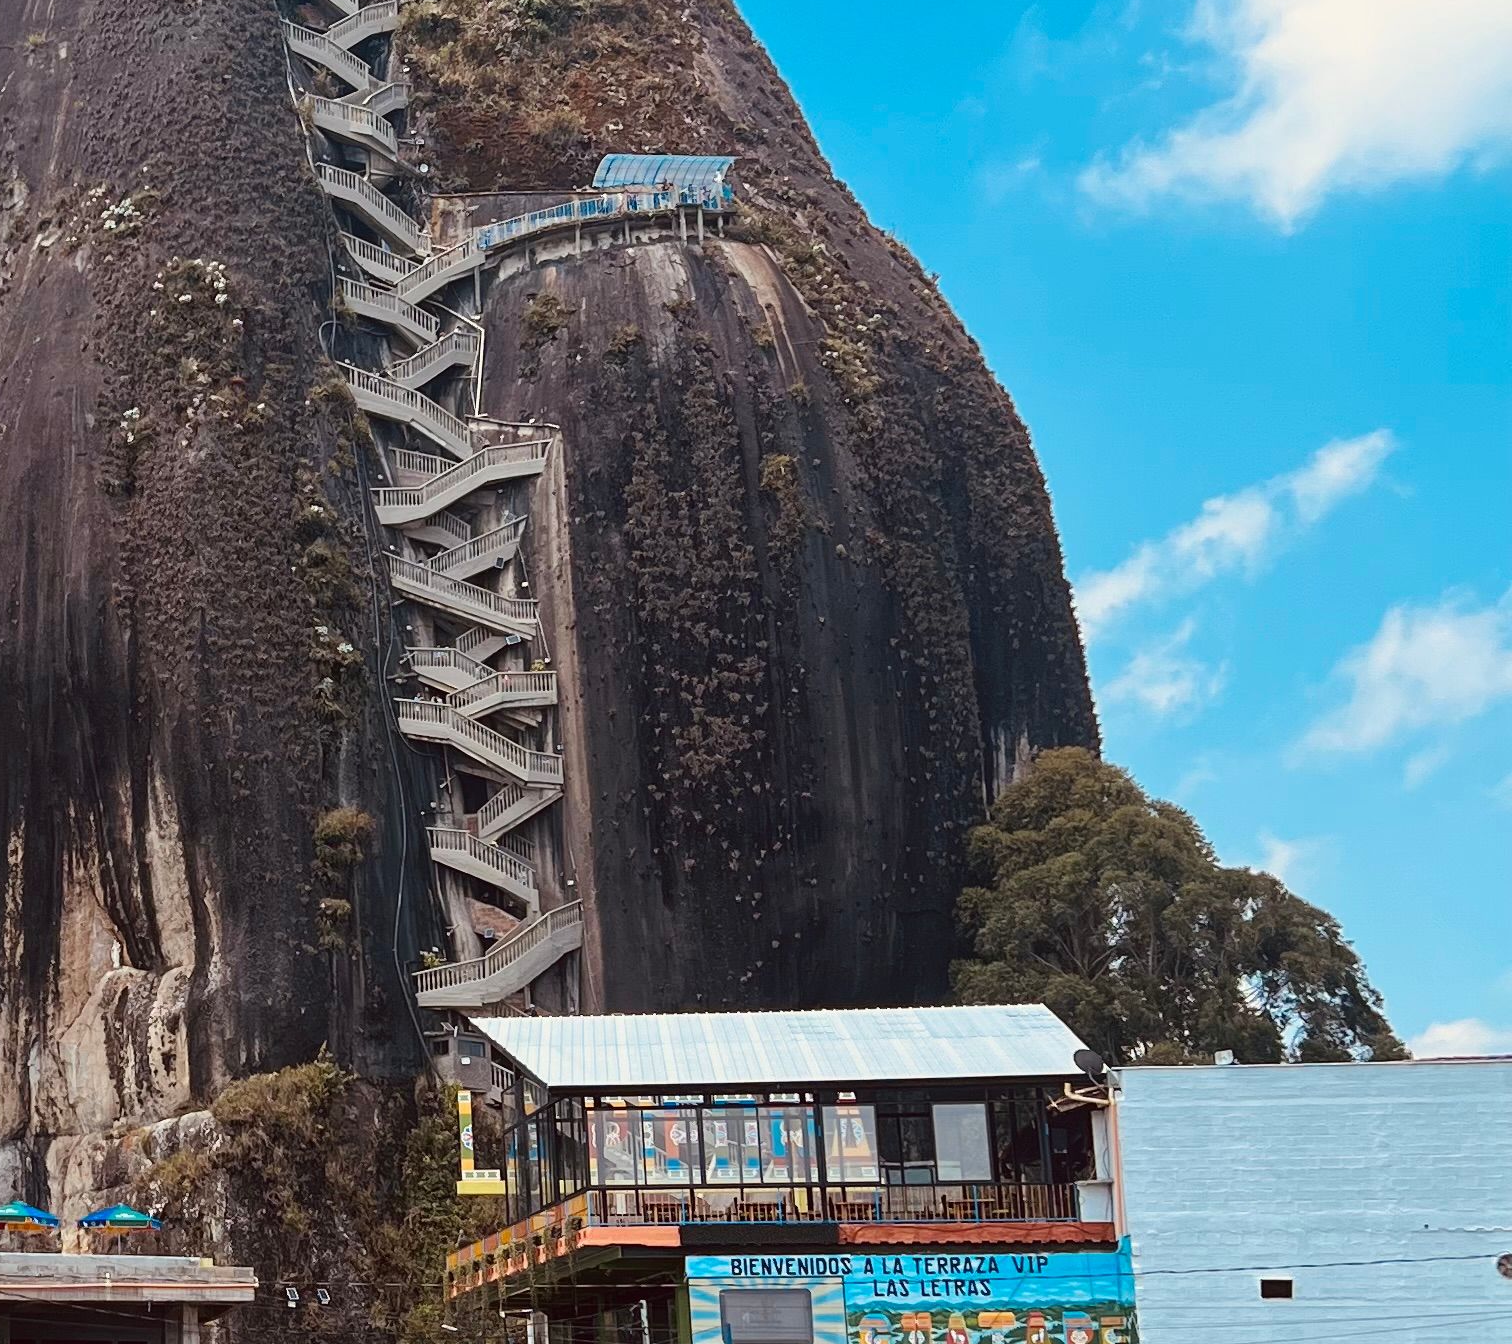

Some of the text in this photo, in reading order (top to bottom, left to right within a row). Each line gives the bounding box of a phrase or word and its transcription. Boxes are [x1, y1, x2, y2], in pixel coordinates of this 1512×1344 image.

[730, 1255, 1049, 1276] BIENVENIDOS A LA TERRAZA VIP
[873, 1279, 992, 1297] LAS LETRAS
